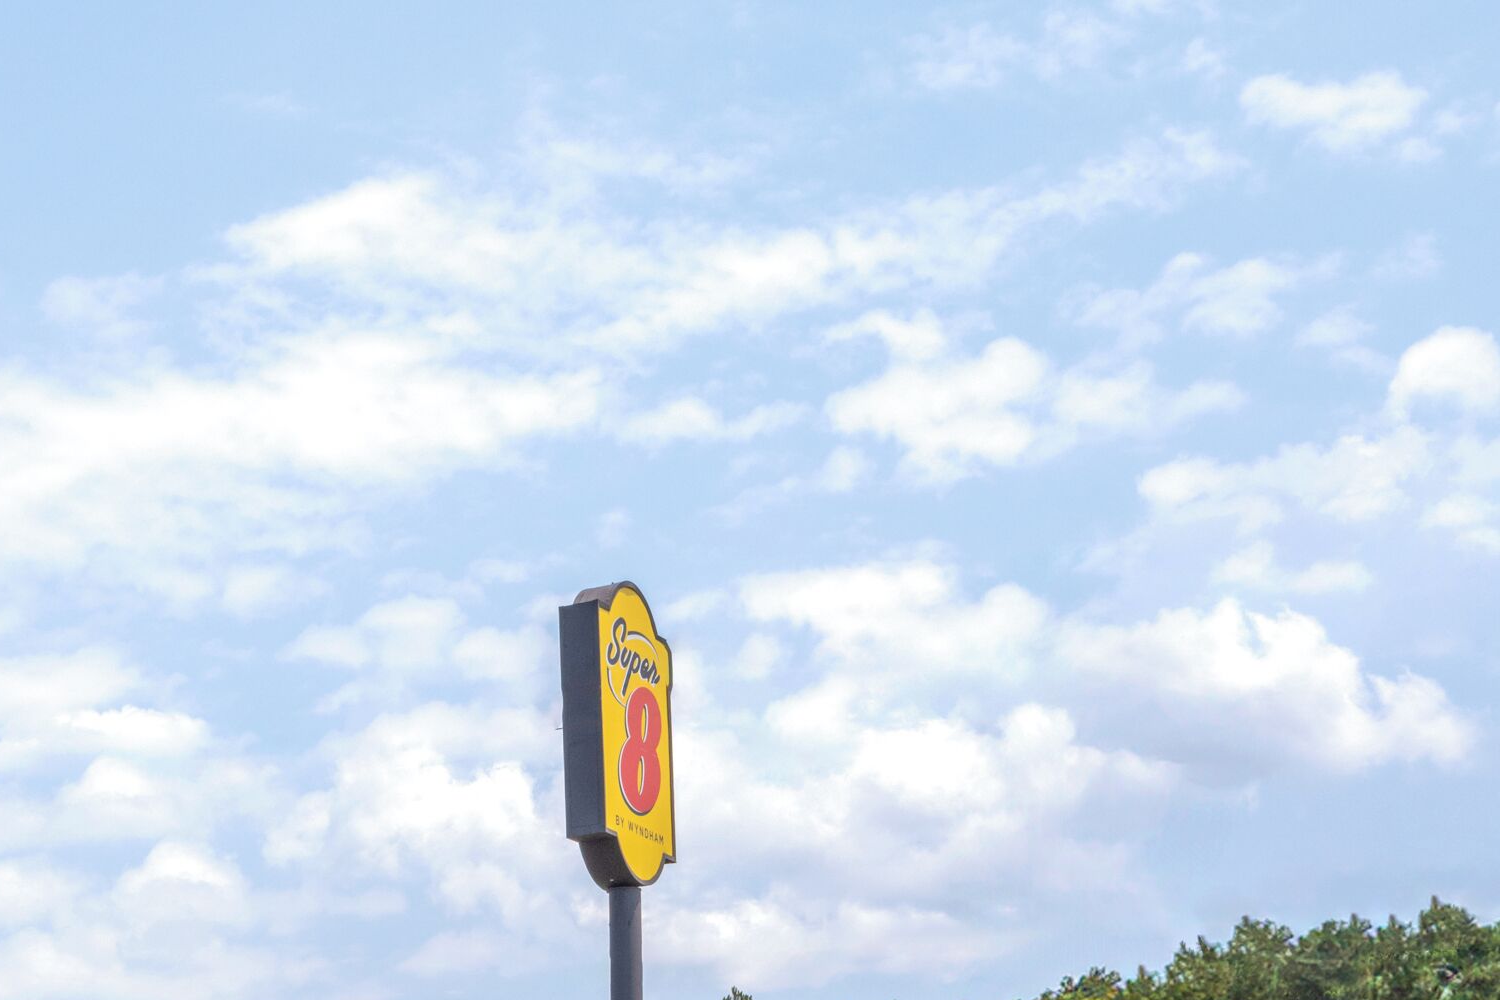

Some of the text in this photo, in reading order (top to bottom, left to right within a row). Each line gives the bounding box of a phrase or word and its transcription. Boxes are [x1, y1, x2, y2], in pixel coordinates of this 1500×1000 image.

[607, 616, 660, 696] Super
[618, 686, 662, 816] 8
[615, 814, 665, 846] BY WYNDHAM
